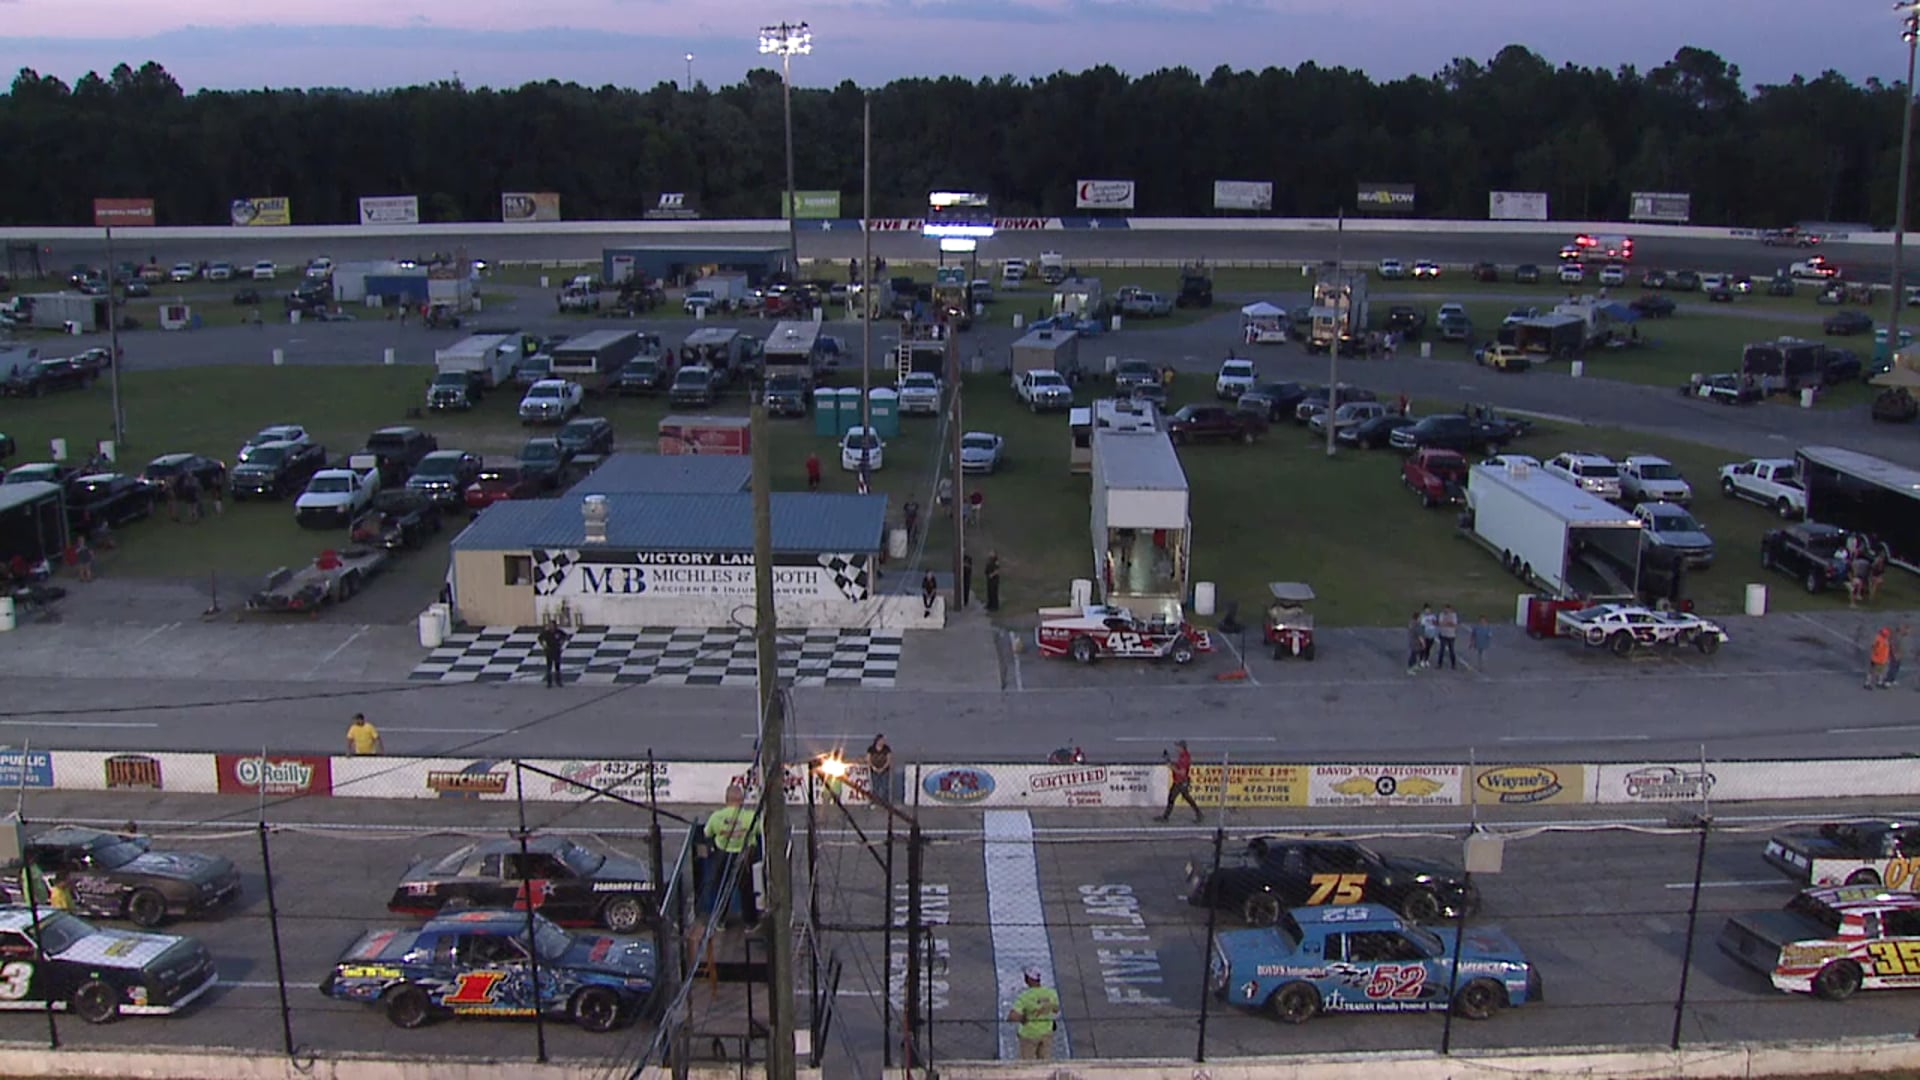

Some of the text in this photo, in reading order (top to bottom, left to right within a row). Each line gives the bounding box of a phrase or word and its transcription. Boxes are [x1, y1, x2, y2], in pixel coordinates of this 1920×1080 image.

[637, 553, 757, 565] VICTORY LAN
[653, 569, 733, 583] MICHLES
[1106, 632, 1142, 650] 42
[239, 757, 314, 786] O'Reilly
[1032, 769, 1105, 789] CERTIFIED
[1317, 767, 1458, 776] DAVID TAU AUTOMOTIVE
[1486, 773, 1551, 789] Wayne's
[1306, 873, 1368, 905] 75
[1077, 883, 1151, 942] FLAGS
[442, 970, 509, 1005] 1
[1096, 949, 1172, 1003] FIVE
[1364, 963, 1429, 1000] 52
